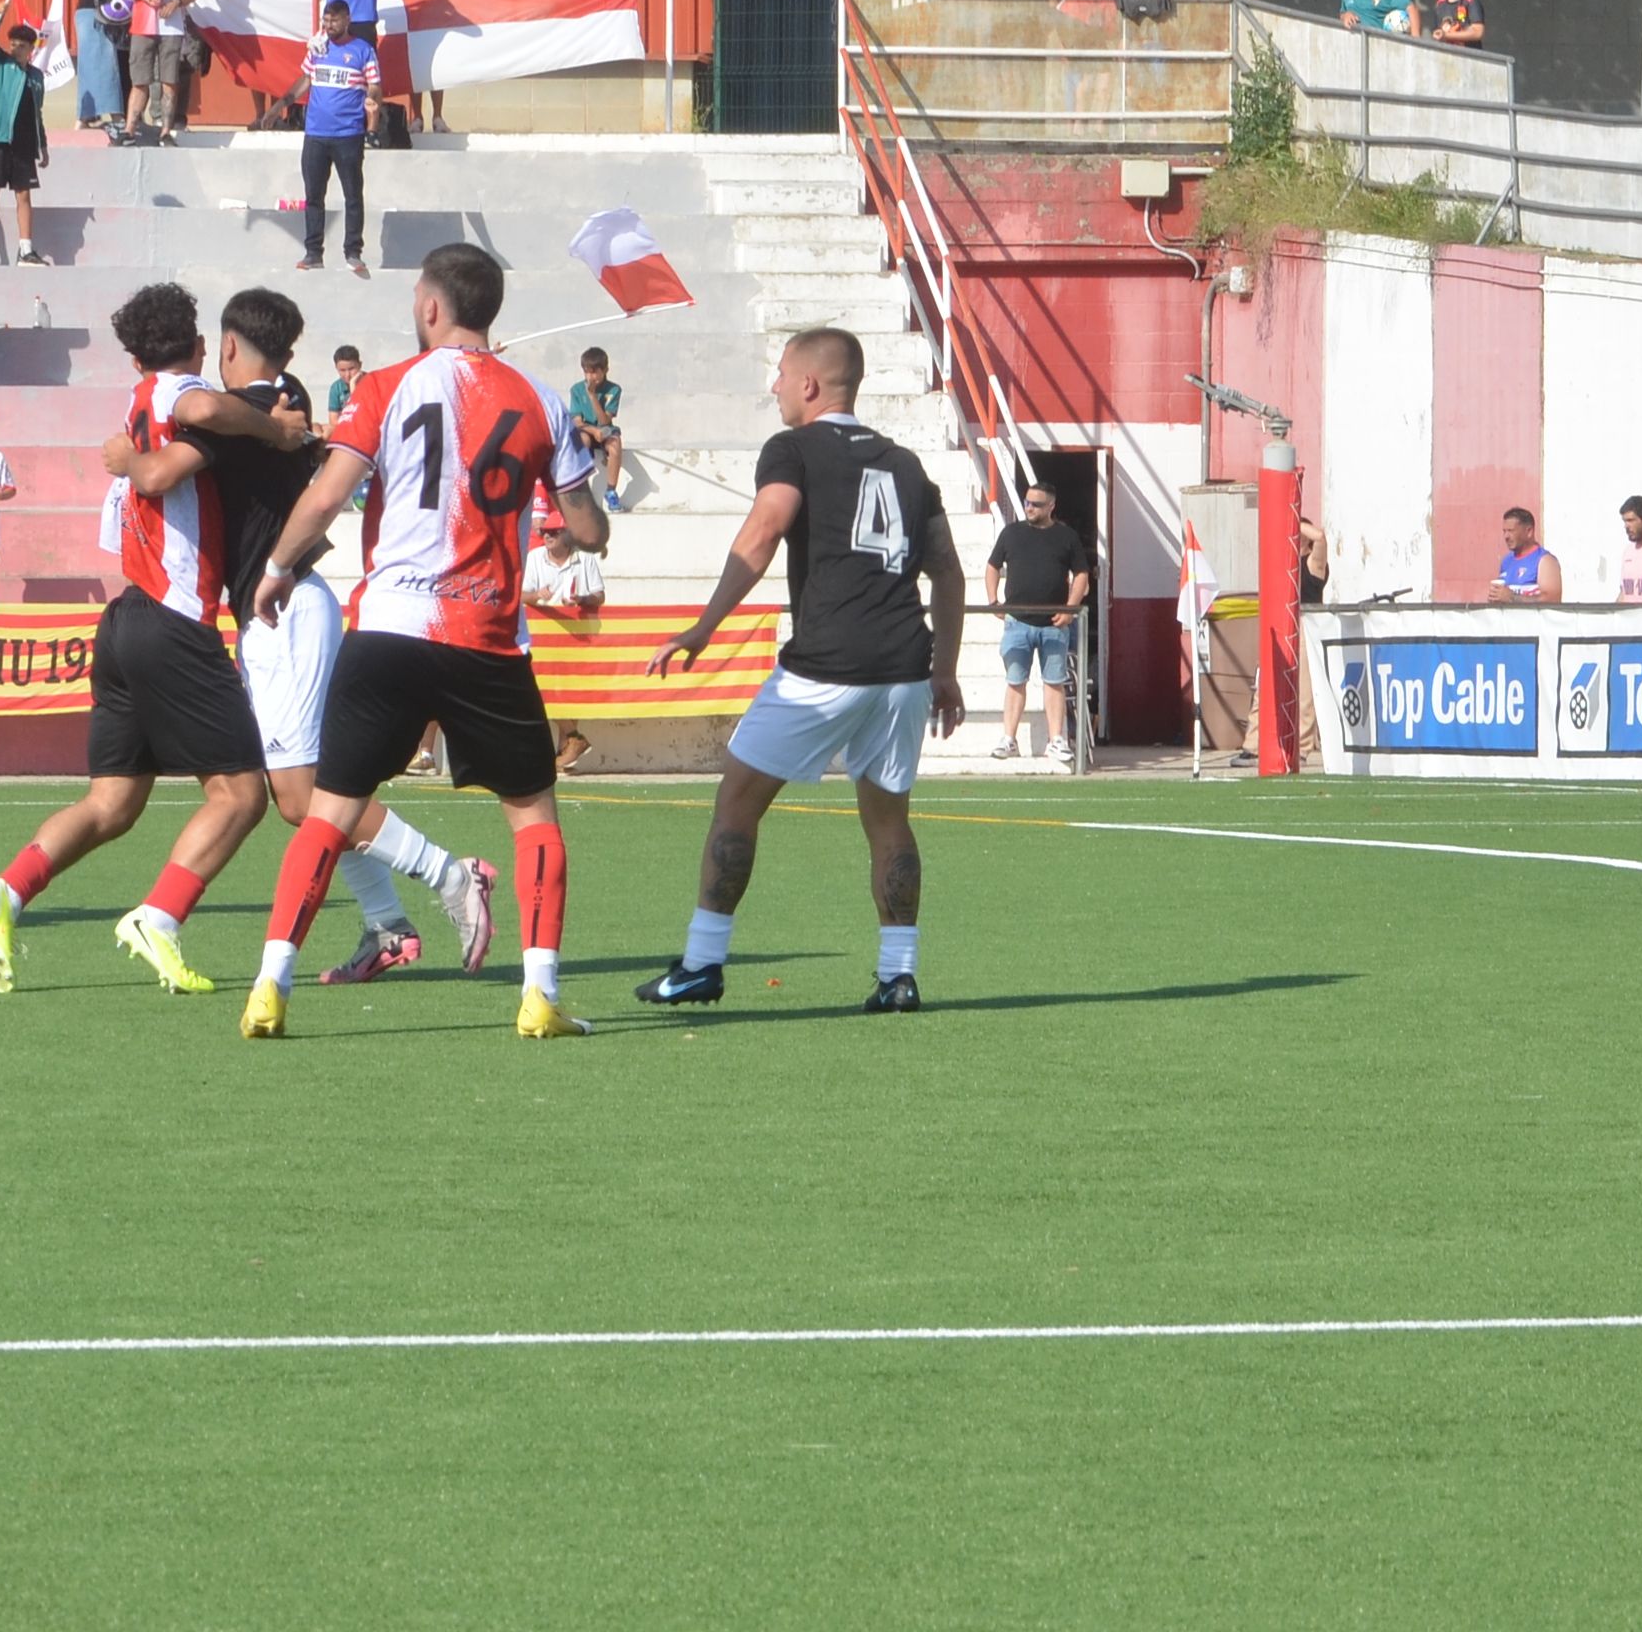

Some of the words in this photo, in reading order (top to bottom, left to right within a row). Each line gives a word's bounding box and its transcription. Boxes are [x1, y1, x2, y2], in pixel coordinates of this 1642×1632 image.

[401, 402, 525, 517] 16
[851, 468, 909, 574] 4
[1377, 663, 1424, 740] Top
[1431, 662, 1525, 725] Cable
